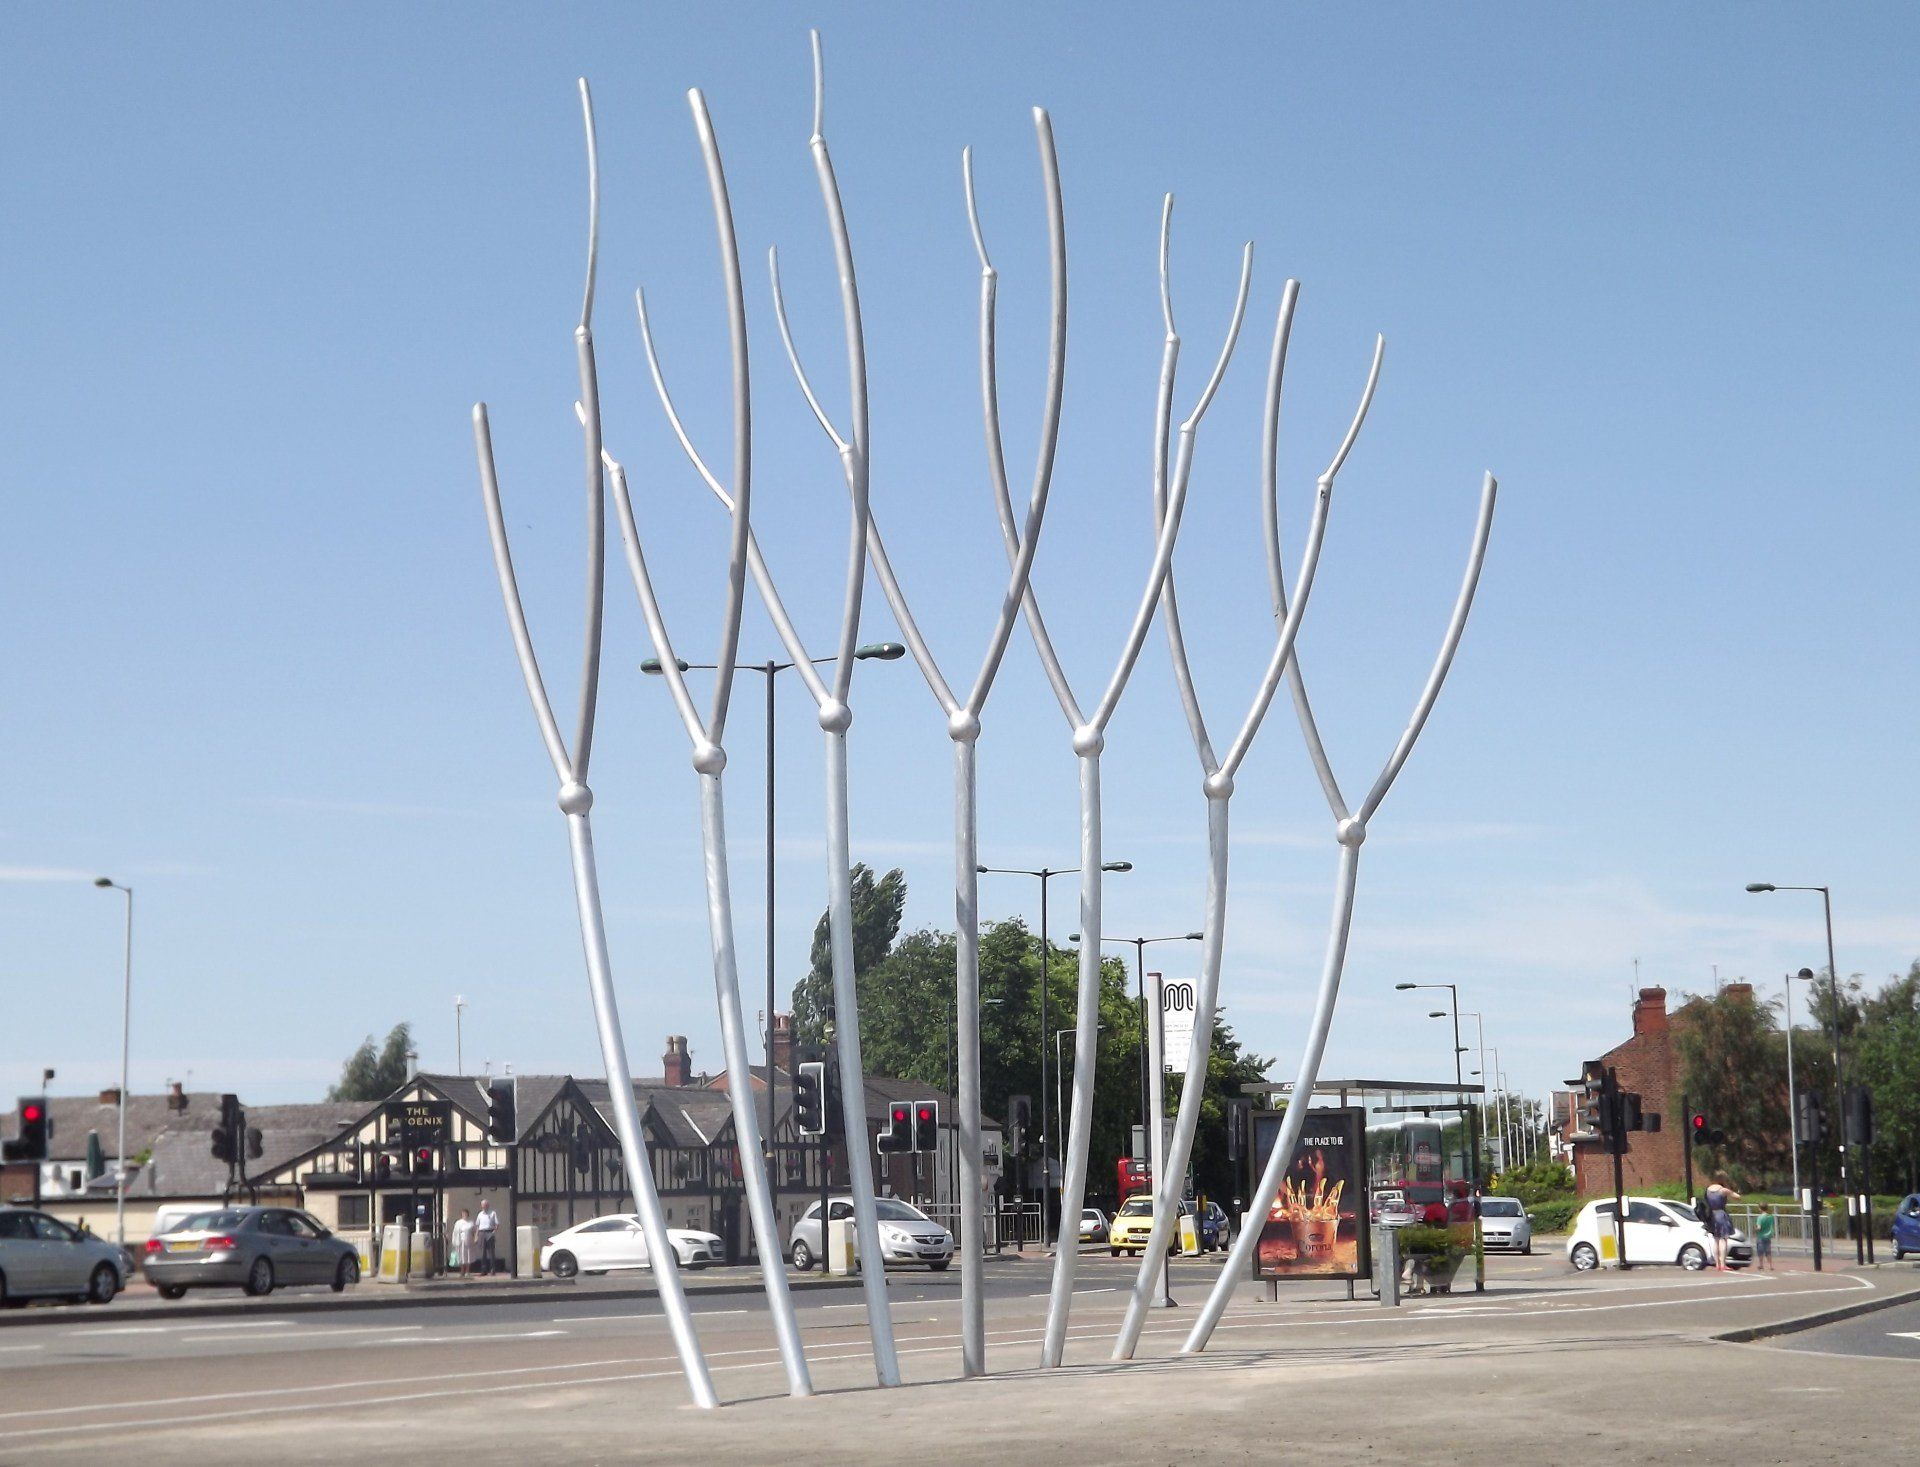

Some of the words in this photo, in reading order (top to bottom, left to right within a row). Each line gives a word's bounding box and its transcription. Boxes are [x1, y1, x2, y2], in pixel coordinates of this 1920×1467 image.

[406, 1107, 429, 1116] THE
[392, 1117, 443, 1126] POENIX
[1304, 1137, 1314, 1146] THE
[1314, 1137, 1330, 1146] PLACE
[1330, 1136, 1337, 1145] TO
[1337, 1136, 1344, 1145] BE
